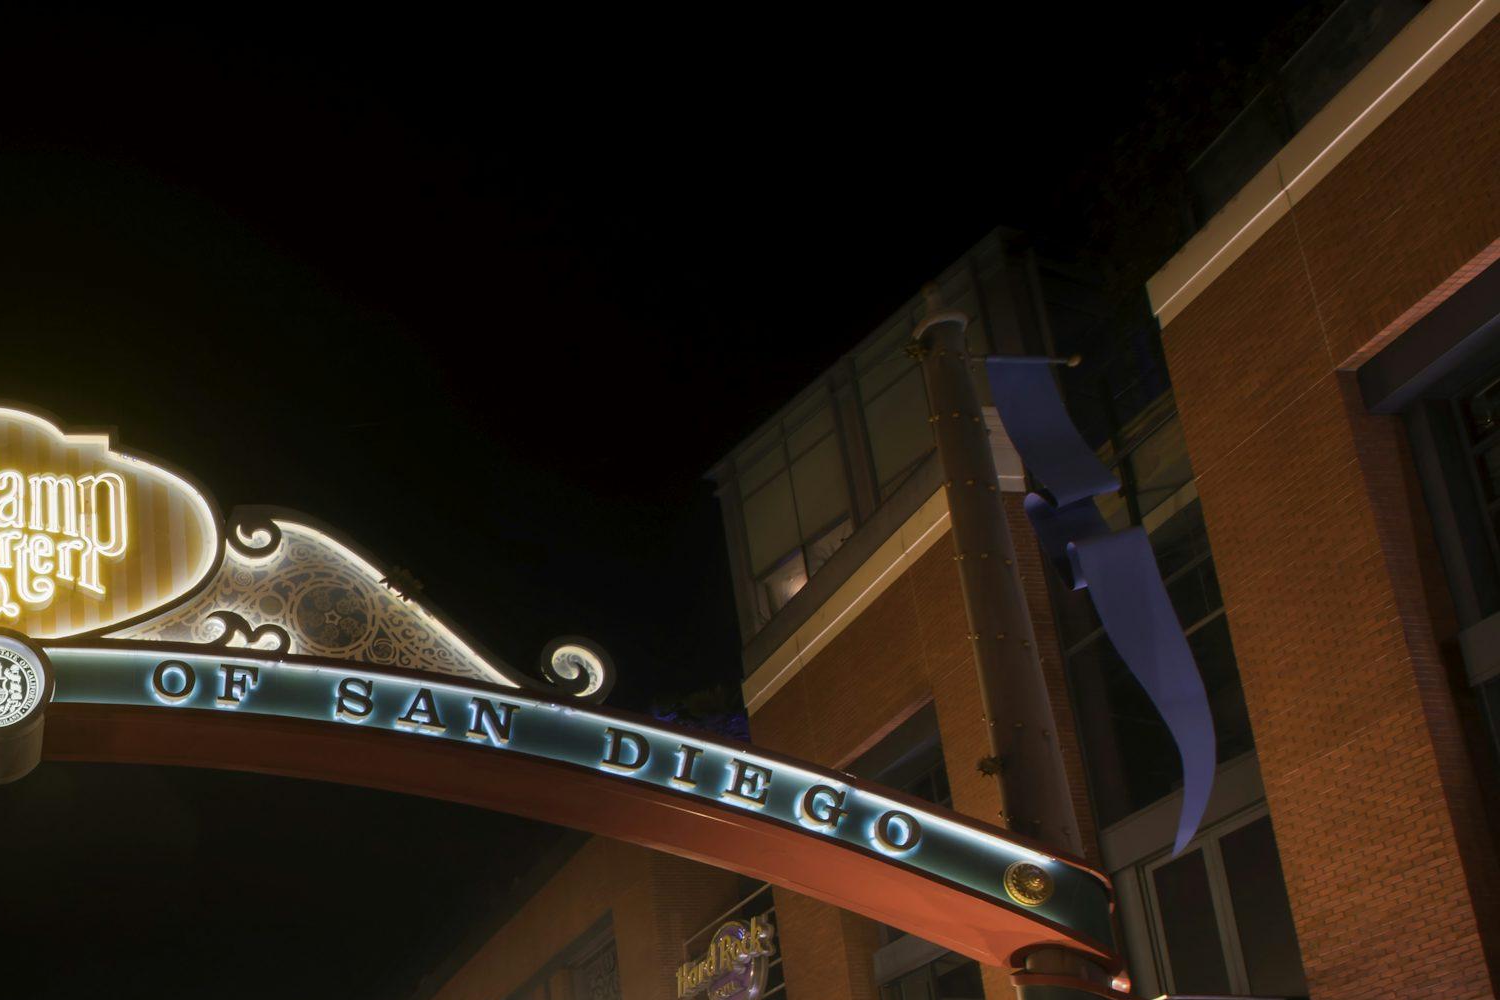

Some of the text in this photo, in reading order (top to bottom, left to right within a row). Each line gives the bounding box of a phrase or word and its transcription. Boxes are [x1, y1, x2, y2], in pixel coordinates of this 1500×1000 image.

[153, 659, 259, 706] OF
[336, 678, 520, 745] SAN
[603, 727, 922, 857] DIEGO
[676, 916, 775, 998] Hard Rock
